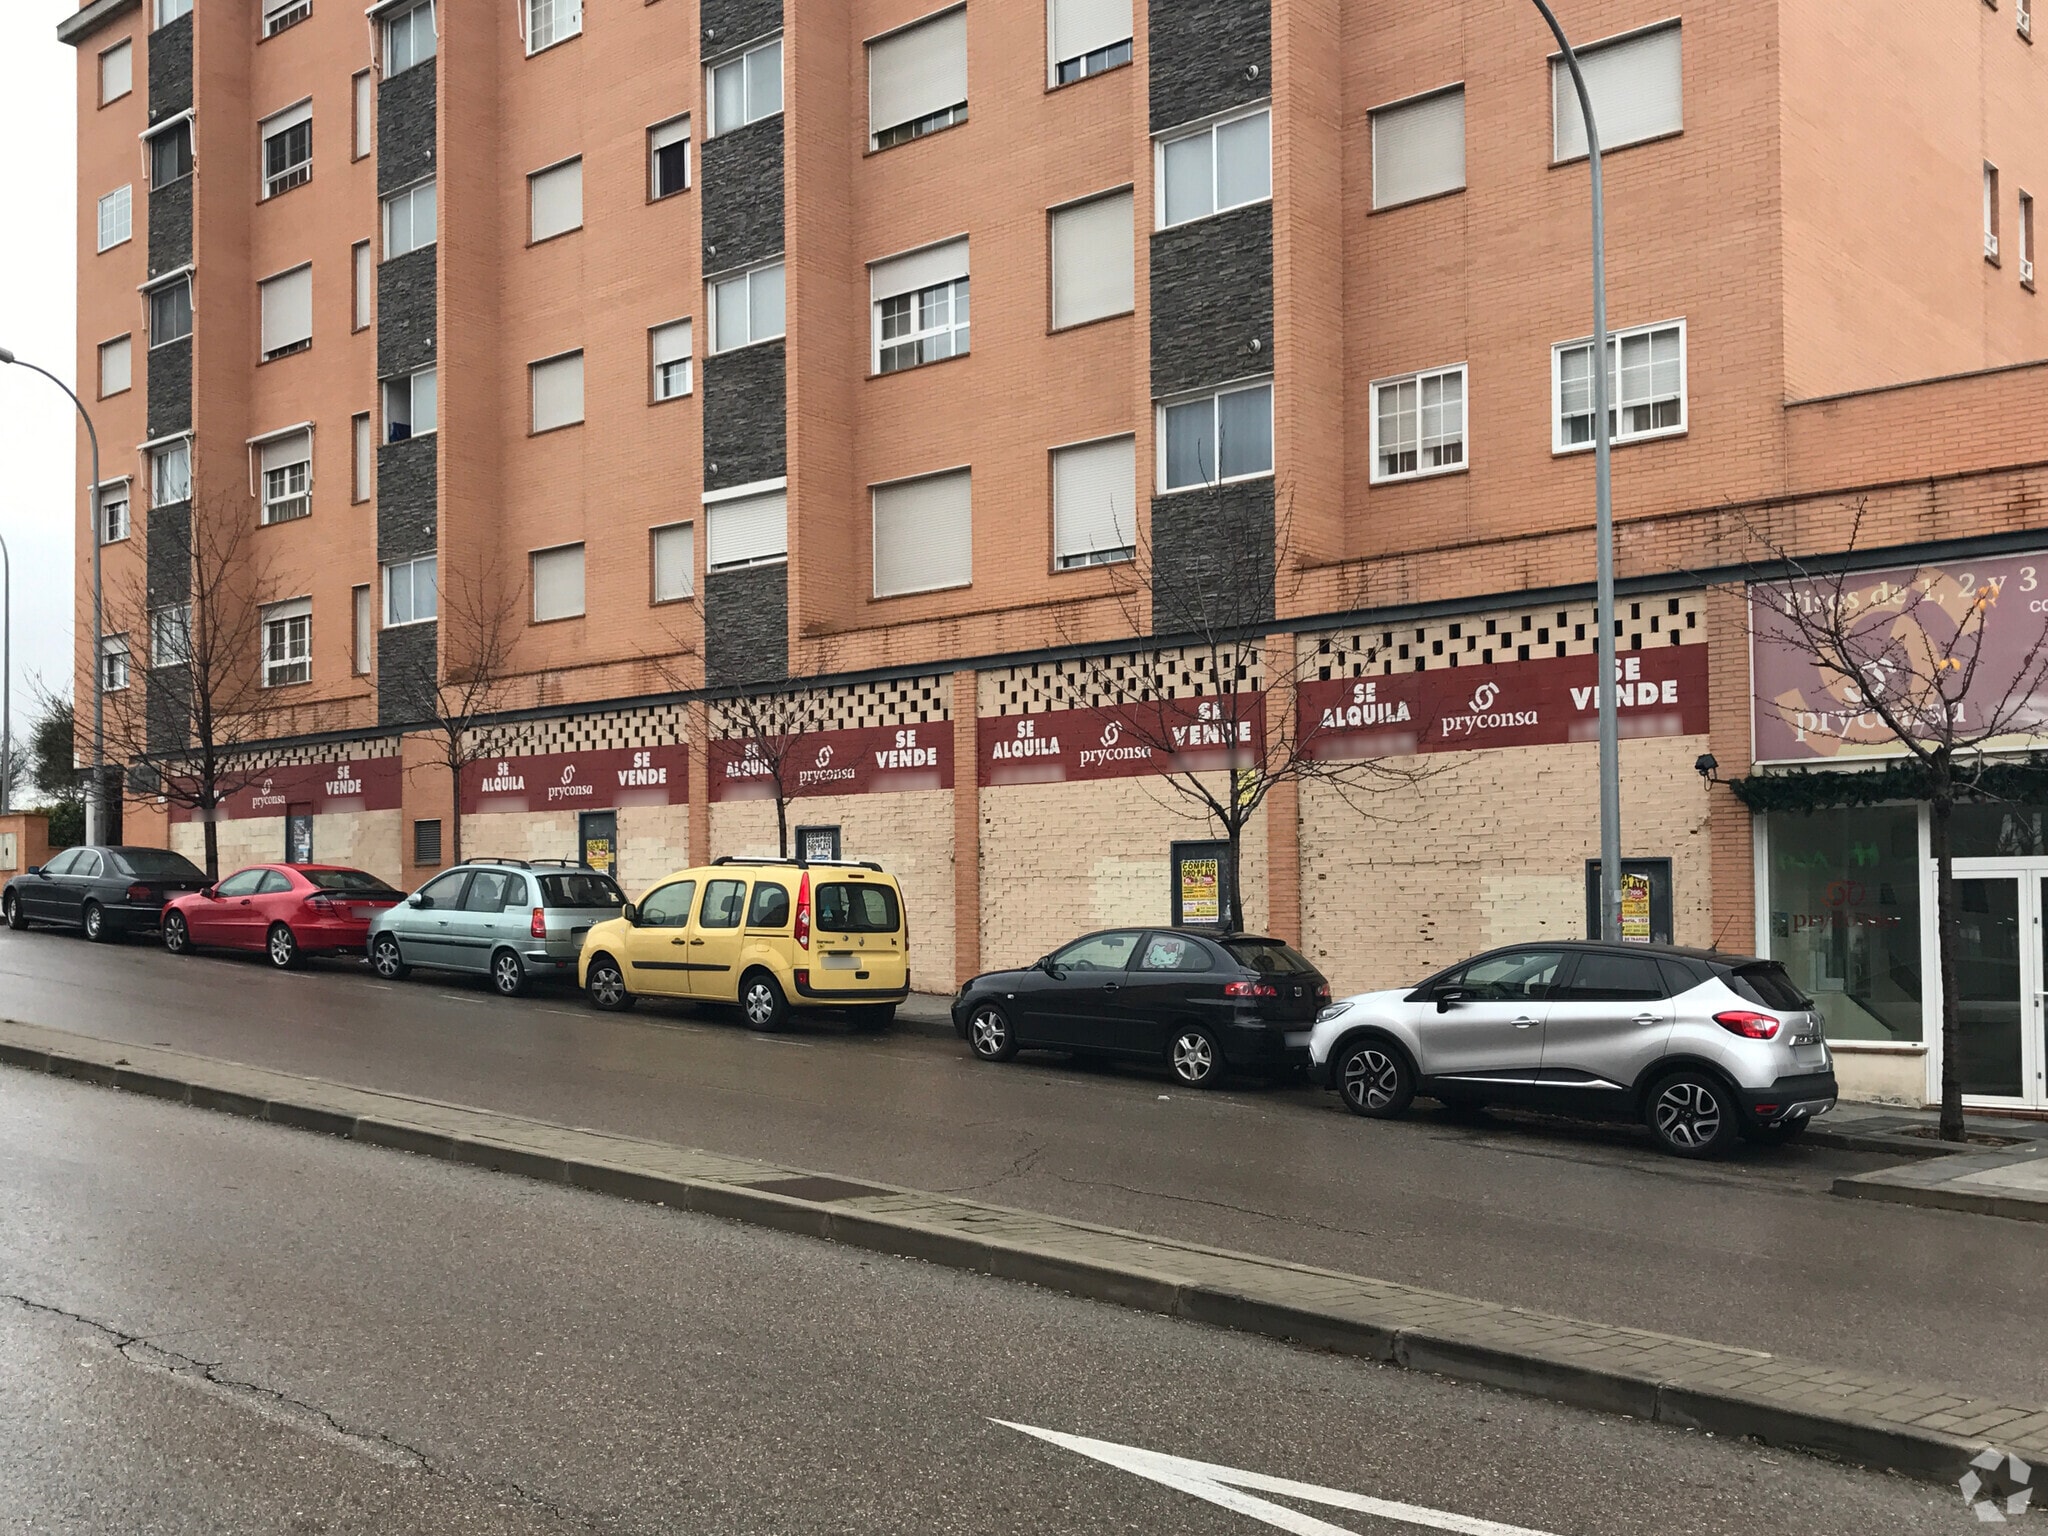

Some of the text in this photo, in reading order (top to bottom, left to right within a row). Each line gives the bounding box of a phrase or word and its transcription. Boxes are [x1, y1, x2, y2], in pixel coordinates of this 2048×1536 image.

[1783, 590, 1860, 615] Pisos
[1870, 581, 1907, 605] de
[1958, 573, 1976, 597] 2
[2019, 566, 2038, 592] 3
[1353, 682, 1376, 704] SE
[1197, 701, 1224, 723] SE
[1320, 701, 1411, 729] ALQUILA
[1017, 720, 1035, 739] SE
[1441, 710, 1538, 737] pryconsa
[895, 730, 916, 749] SE
[1171, 721, 1252, 747] VENDE
[744, 742, 759, 758] SE
[992, 736, 1061, 760] ALQUILA
[1079, 745, 1152, 767] pryconsa
[633, 752, 651, 768] SE
[875, 747, 937, 769] VENDE
[337, 765, 350, 779] SE
[497, 762, 509, 776] SE
[617, 767, 667, 786] VENDE
[726, 758, 775, 778] ALQUIL
[799, 766, 856, 786] pryconsa
[325, 778, 362, 796] VENDE
[481, 775, 525, 792] ALQUILA
[548, 784, 593, 801] pryconsa
[252, 794, 286, 809] pryconsa
[1622, 880, 1647, 889] PLATA
